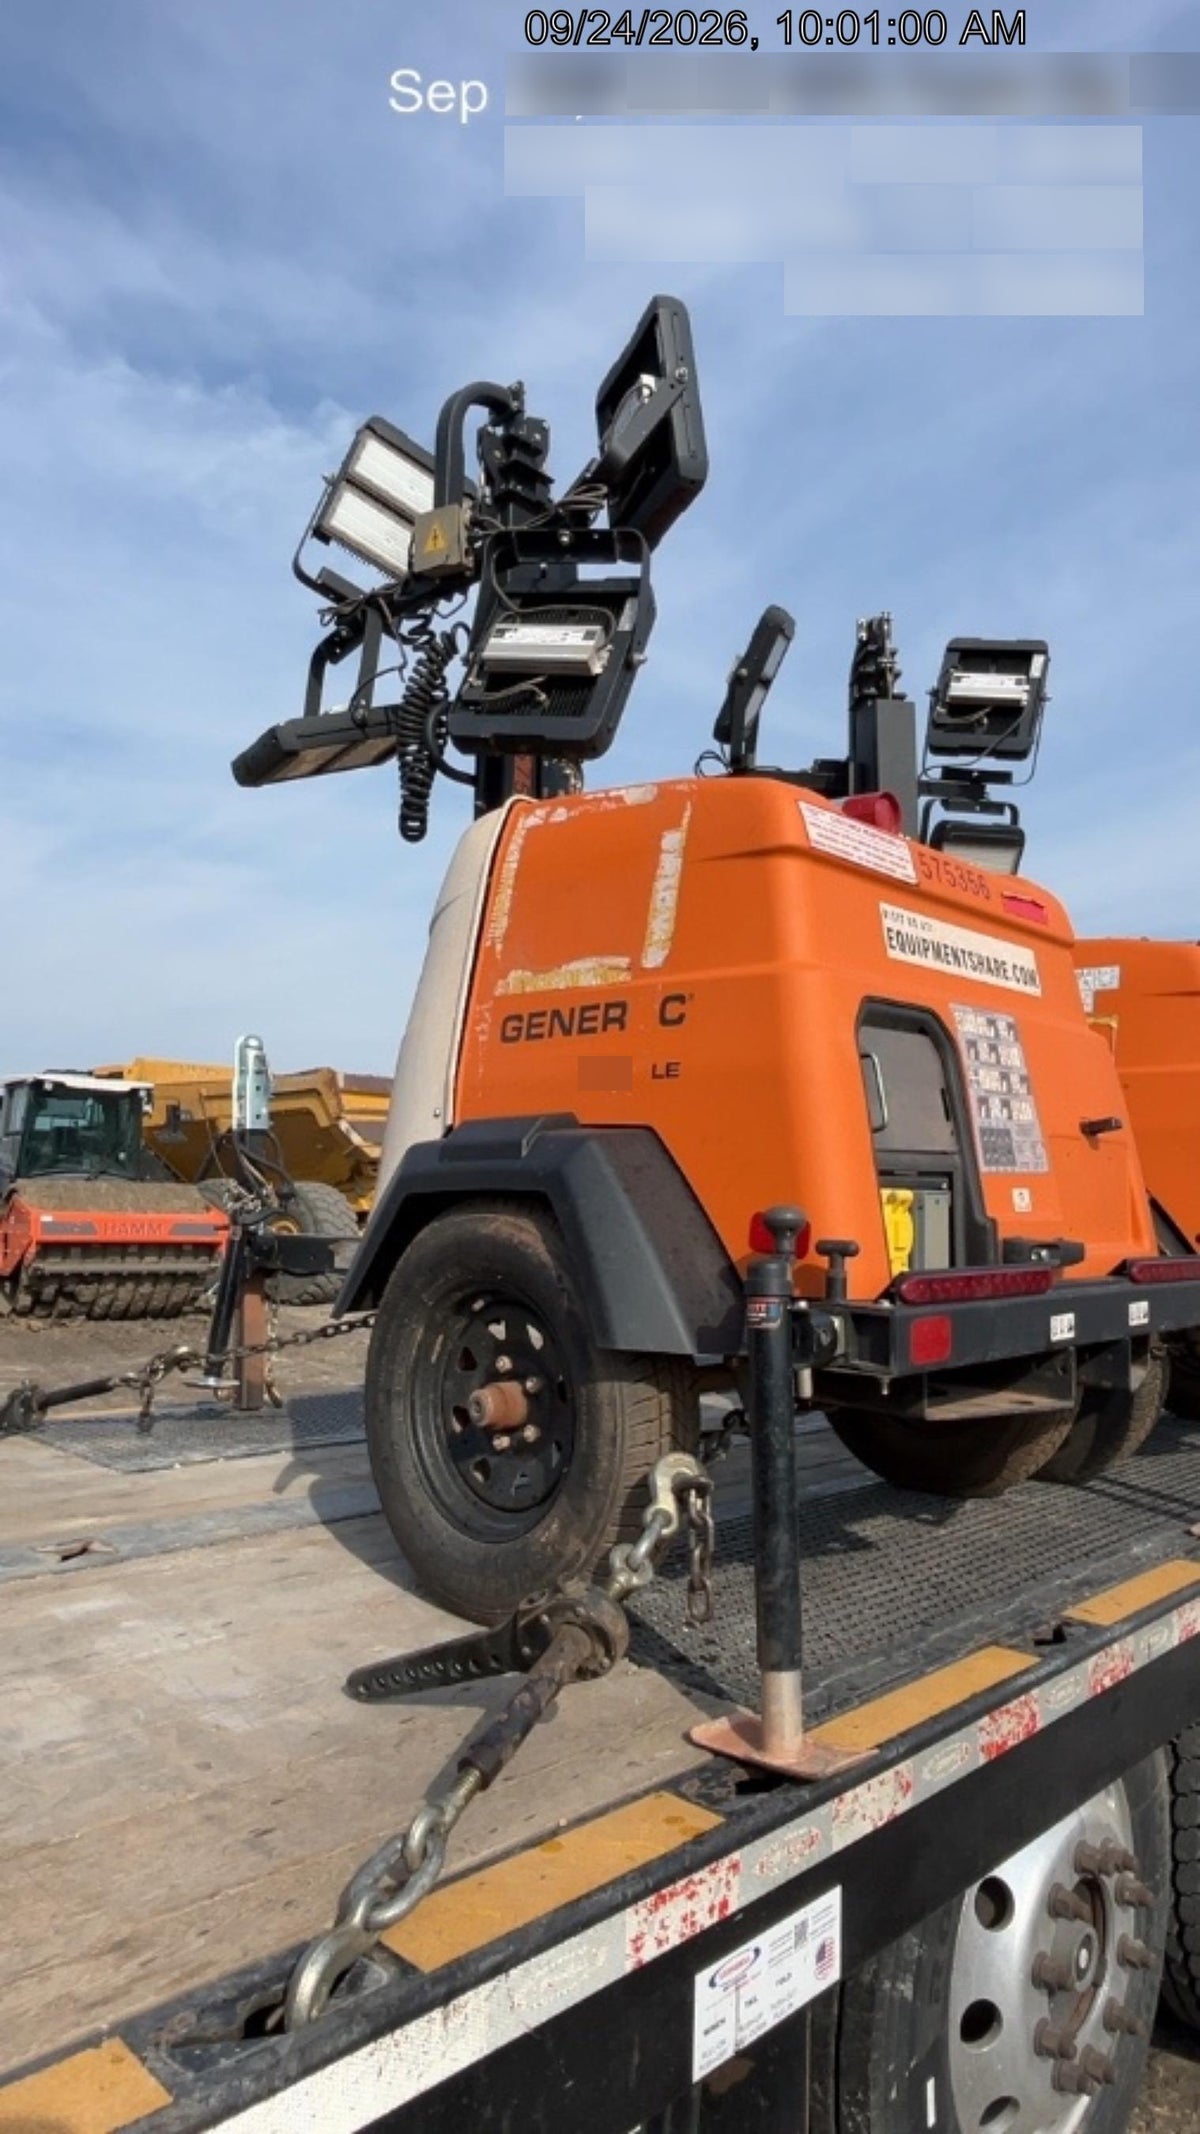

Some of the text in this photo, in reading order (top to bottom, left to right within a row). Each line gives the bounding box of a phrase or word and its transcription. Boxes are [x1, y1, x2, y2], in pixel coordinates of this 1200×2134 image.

[918, 851, 991, 899] 575356
[885, 926, 1040, 988] EQUIPMENTSHARE.COM
[500, 993, 687, 1044] GENERC
